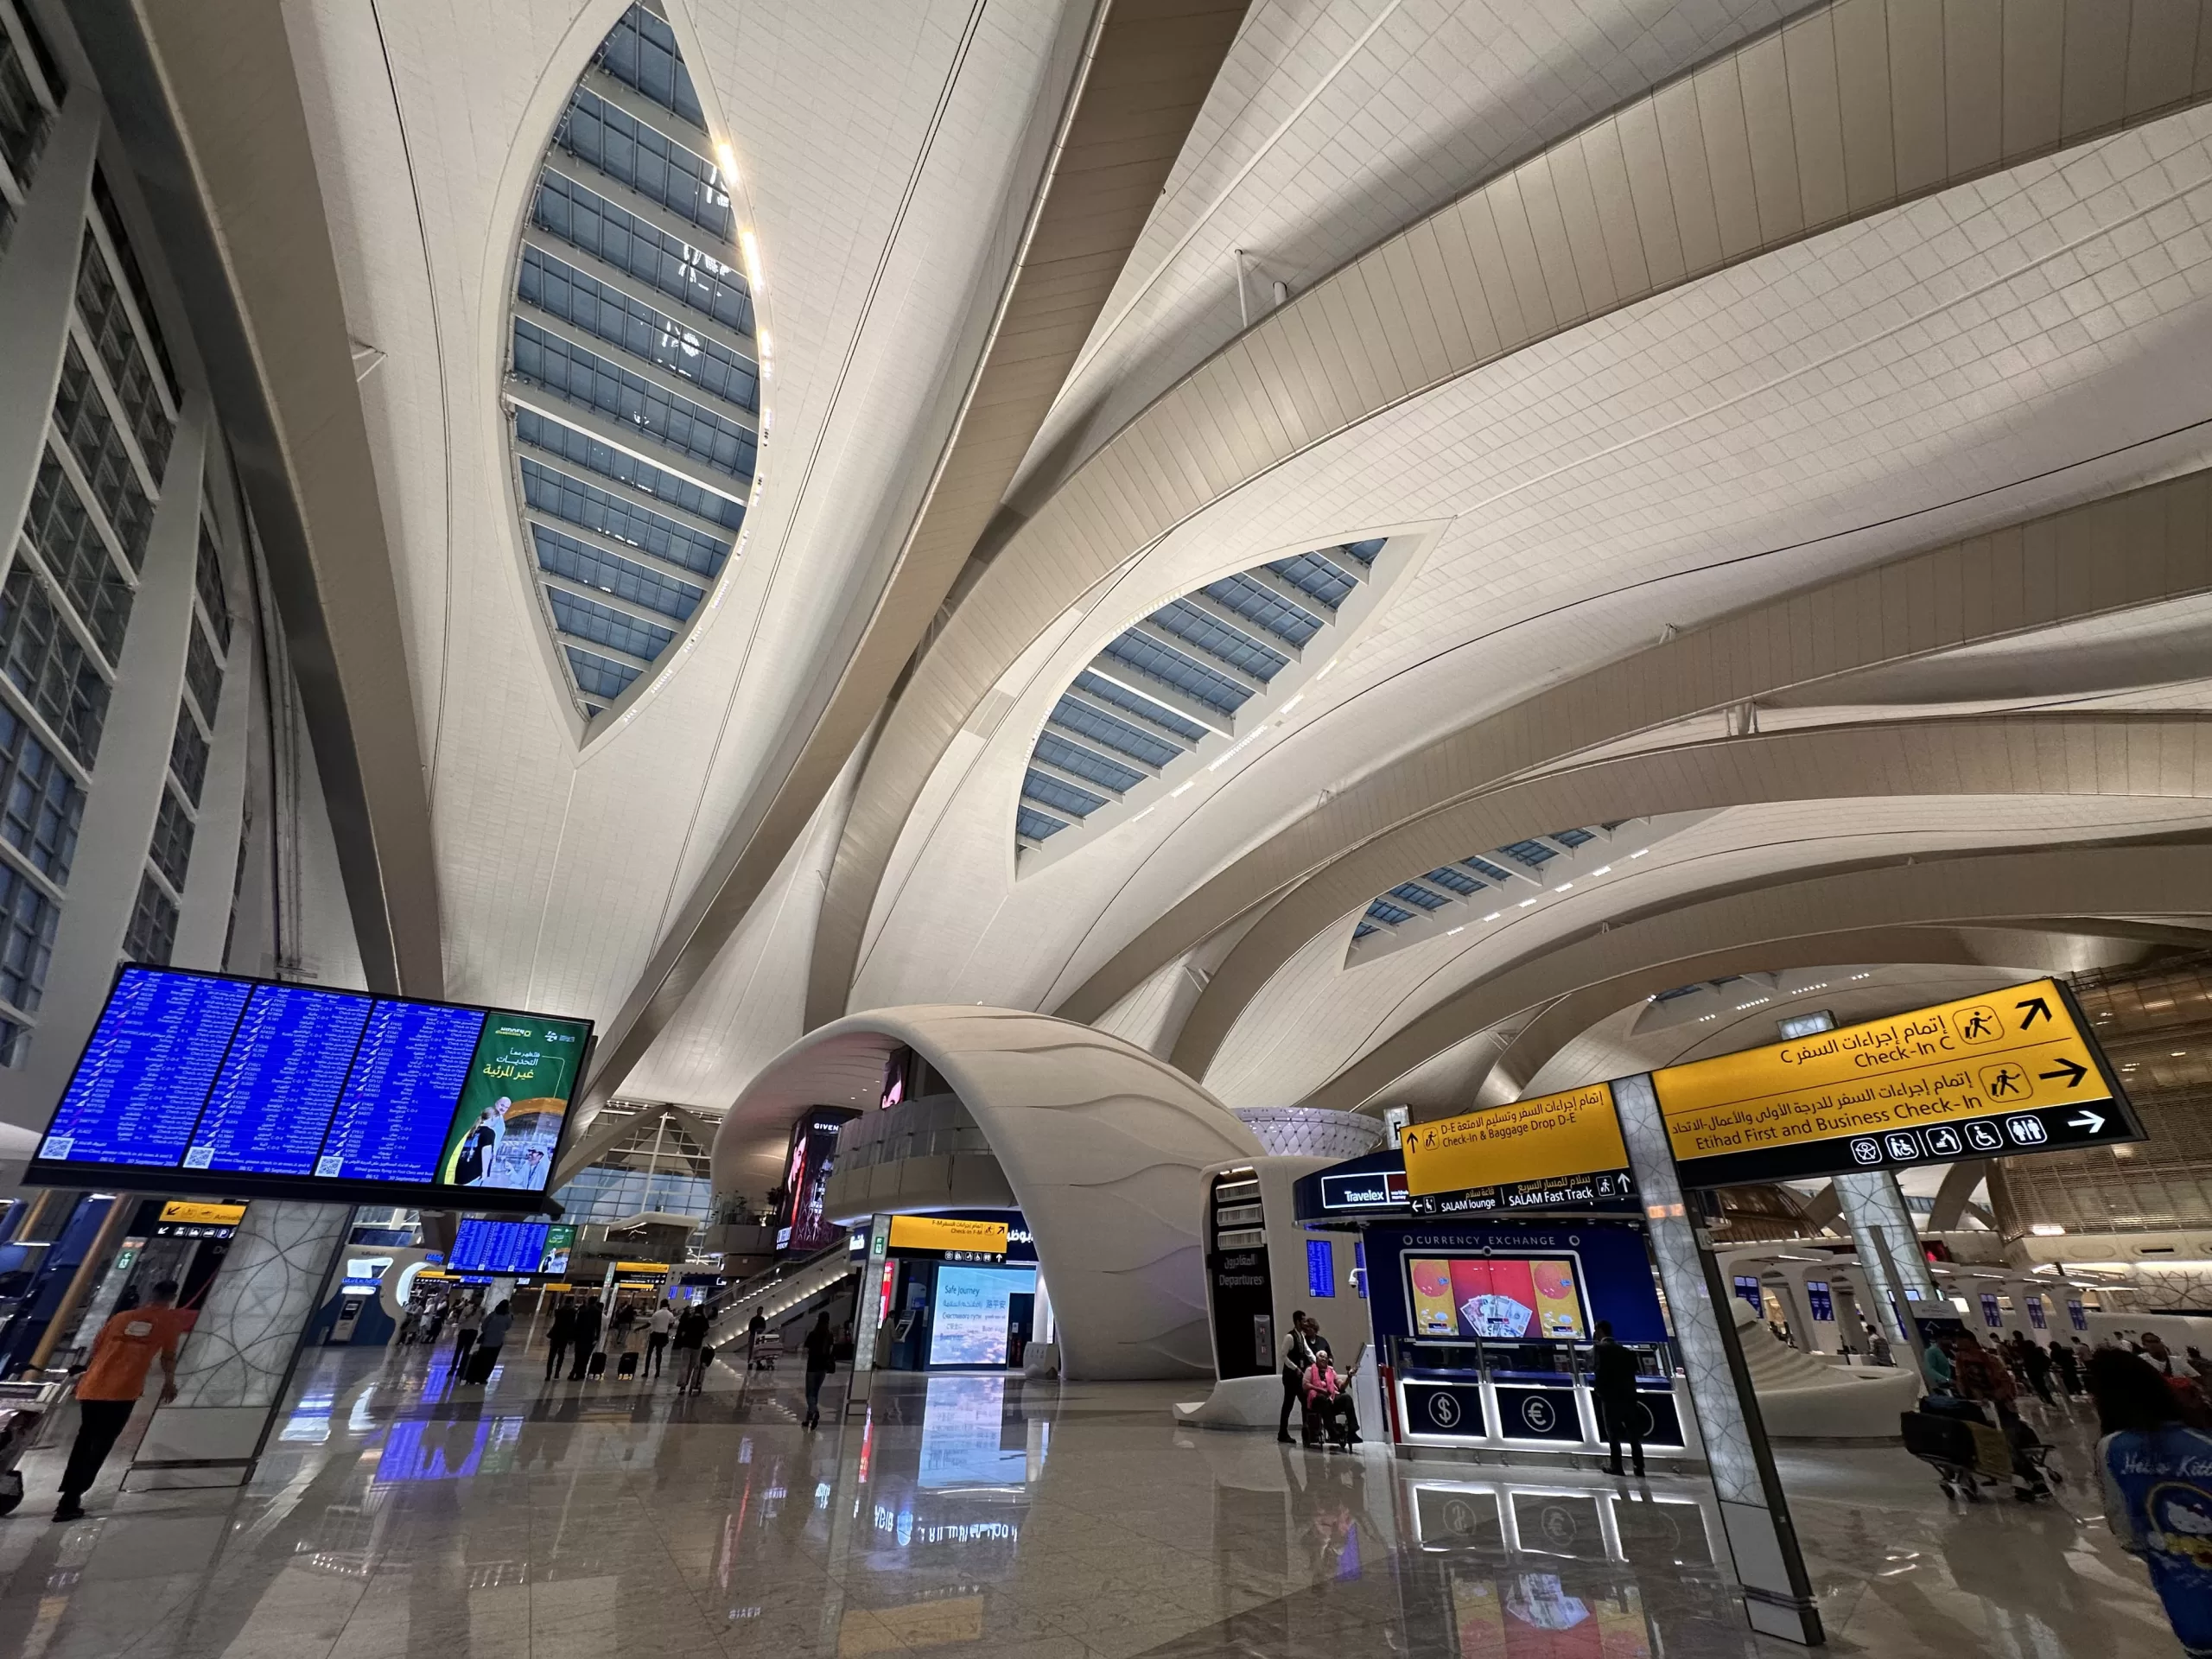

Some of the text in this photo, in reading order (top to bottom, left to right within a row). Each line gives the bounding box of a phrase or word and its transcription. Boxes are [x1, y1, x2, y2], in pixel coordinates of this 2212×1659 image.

[1780, 1015, 1948, 1065] إتمام إجراءات السفر C
[1854, 1036, 1955, 1068] Check-In C
[483, 1064, 534, 1080] غير المرئية
[1878, 1078, 1930, 1098] إجراءات
[1935, 1071, 1974, 1095] إتمام
[1545, 1096, 1577, 1113] إجراءات
[1580, 1090, 1605, 1109] إتمام
[1794, 1096, 1833, 1115] للدرجة
[1837, 1088, 1876, 1109] السفر
[1485, 1109, 1517, 1129] وتسليم
[1518, 1103, 1543, 1122] السفر
[1756, 1103, 1792, 1123] الأولى
[1440, 1123, 1456, 1135] D-E
[1442, 1112, 1577, 1147] Check-In & Baggage Drop D-E
[1695, 1095, 1983, 1150] Etihad First and Business Check-In
[1344, 1189, 1385, 1203] Travelex
[1441, 1198, 1496, 1212] SALAM lounge
[1509, 1186, 1594, 1206] SALAM Fast Track
[1416, 1236, 1556, 1245] CURRENCY EXCHANGE
[944, 1285, 957, 1294] Safe
[1218, 1274, 1265, 1289] Departures
